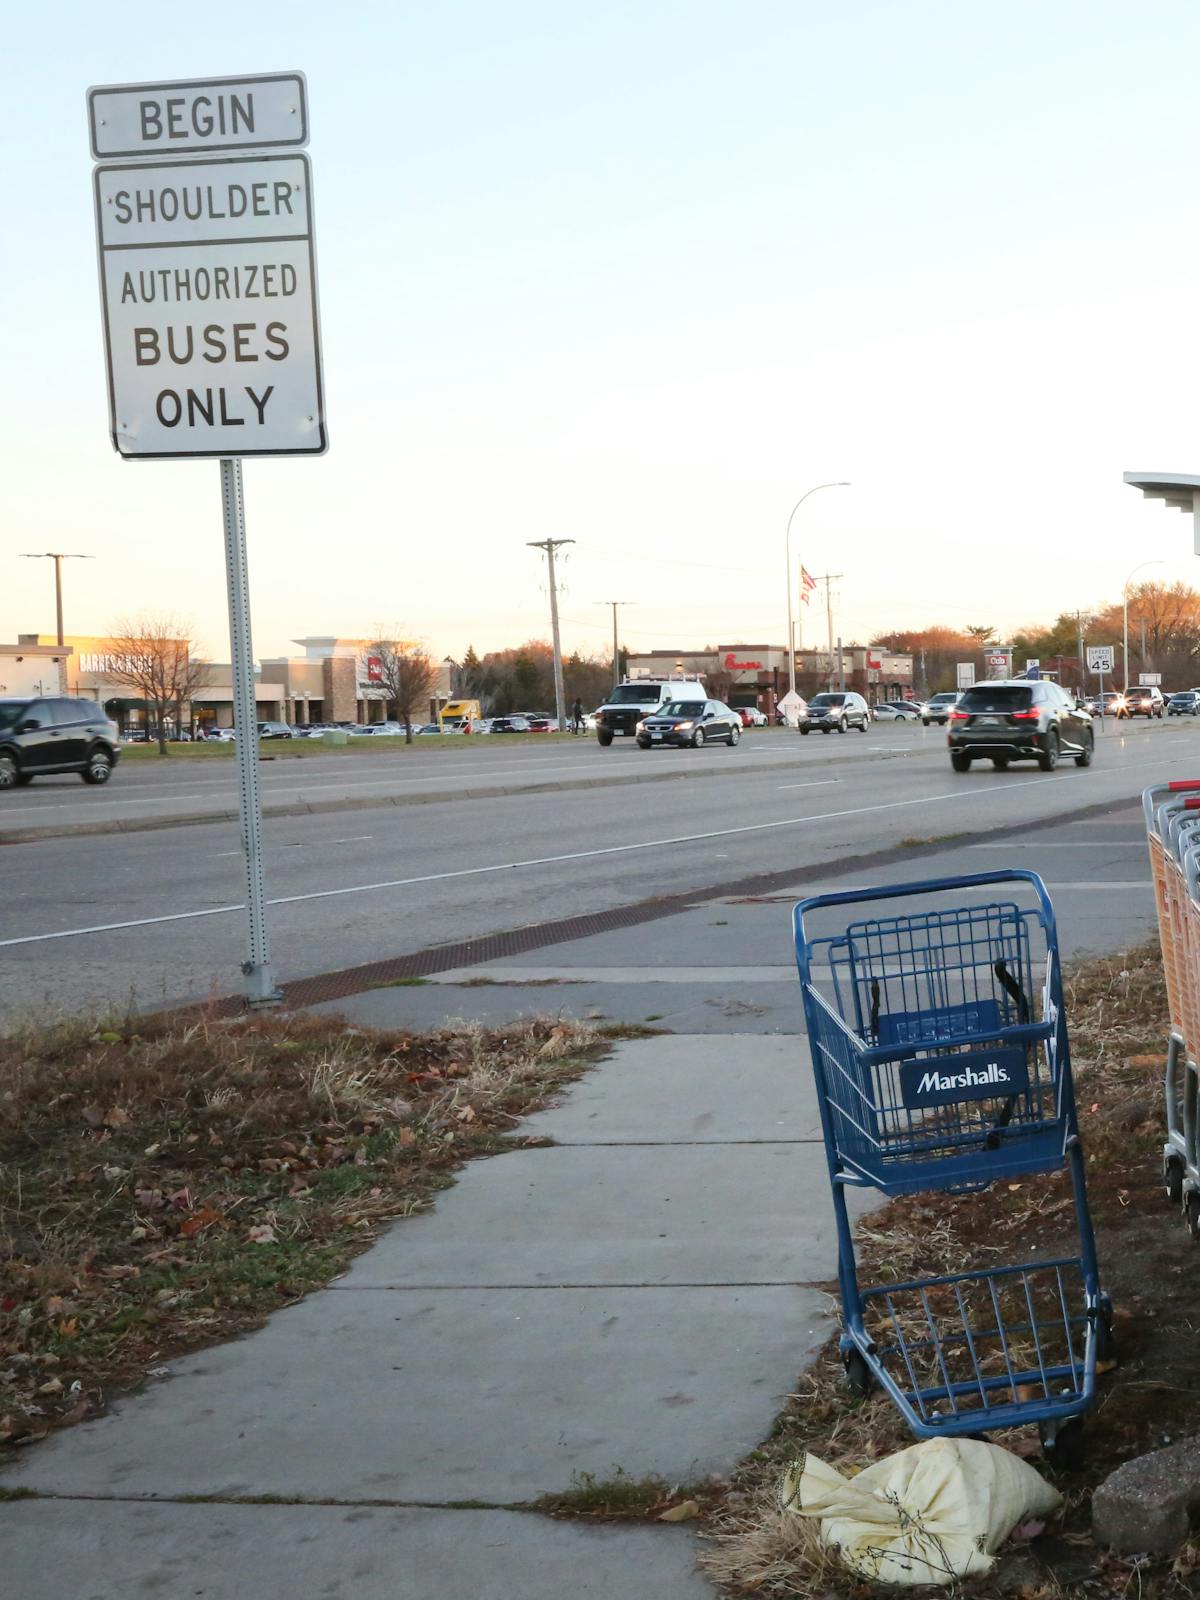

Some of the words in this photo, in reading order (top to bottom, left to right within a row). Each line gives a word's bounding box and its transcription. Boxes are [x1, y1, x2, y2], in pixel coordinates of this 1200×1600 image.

[140, 93, 255, 141] BEGIN
[115, 181, 293, 225] SHOULDER
[121, 263, 297, 304] AUTHORIZED
[134, 321, 290, 366] BUSES
[156, 385, 275, 428] ONLY
[80, 654, 115, 673] BARNES
[1091, 660, 1110, 671] 45
